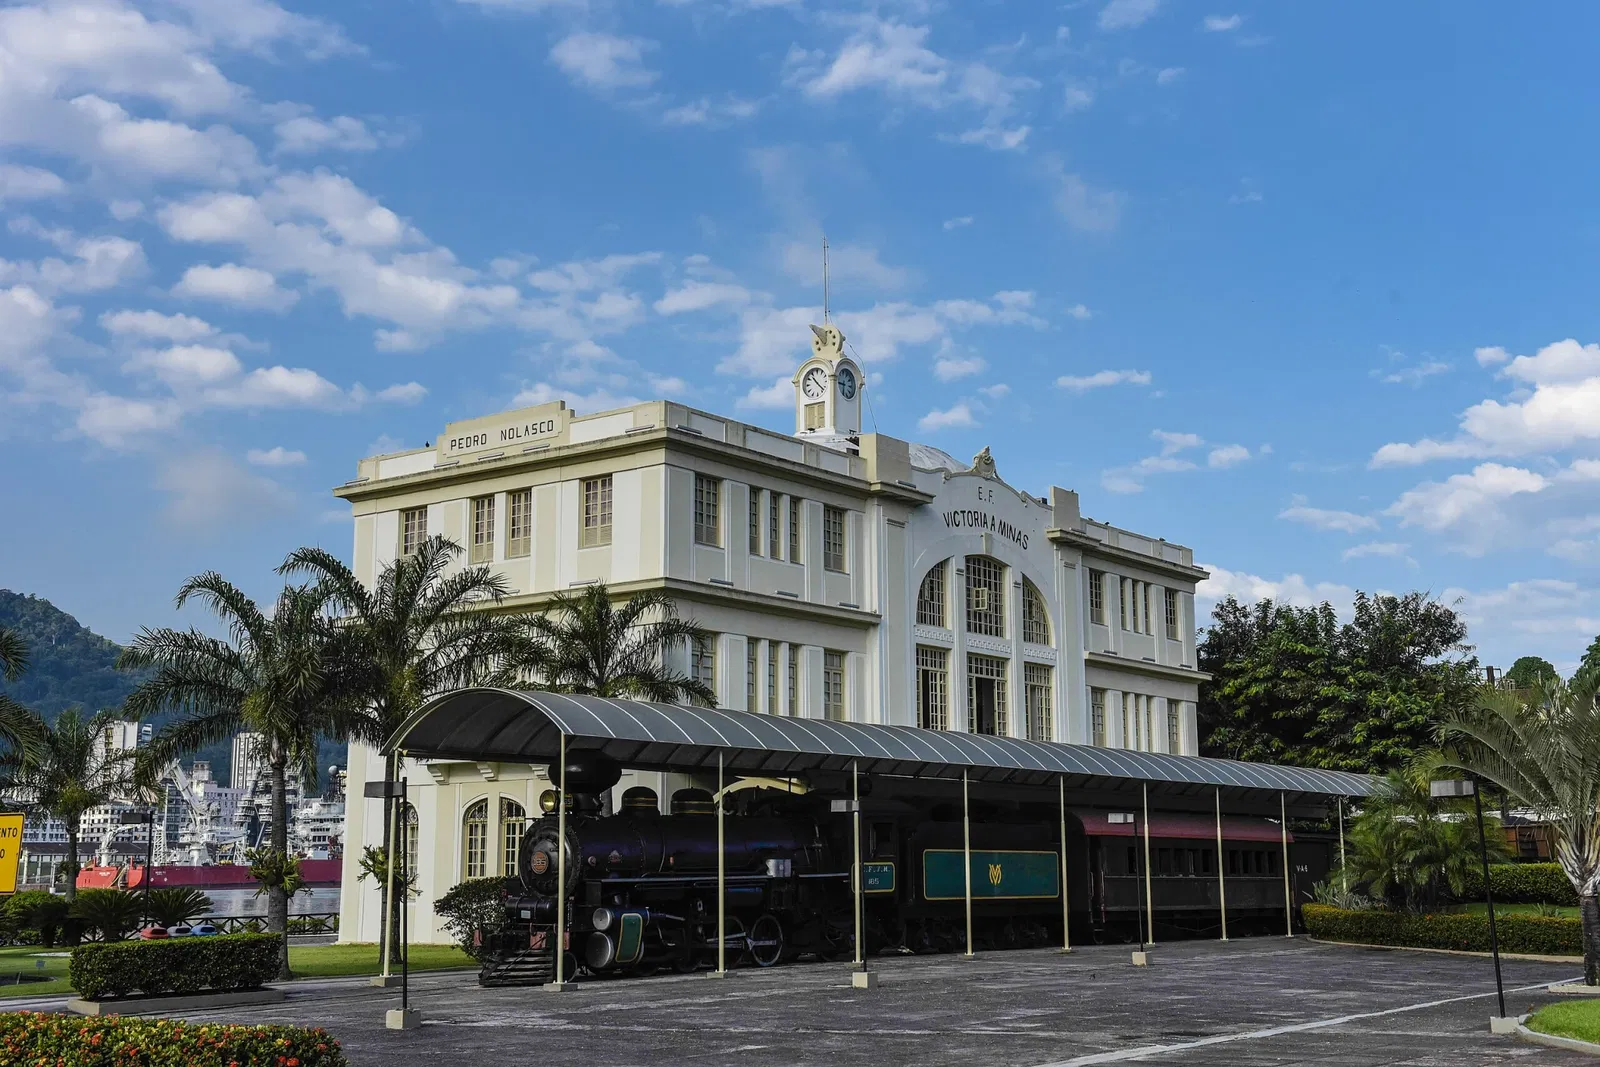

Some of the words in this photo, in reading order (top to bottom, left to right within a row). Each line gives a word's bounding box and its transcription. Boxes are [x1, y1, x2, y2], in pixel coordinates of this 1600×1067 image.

[450, 433, 487, 451] PEDRO
[500, 420, 554, 441] NOLASCO
[942, 510, 989, 529] VICTORIA
[989, 515, 996, 532] A
[997, 519, 1029, 550] MINAS
